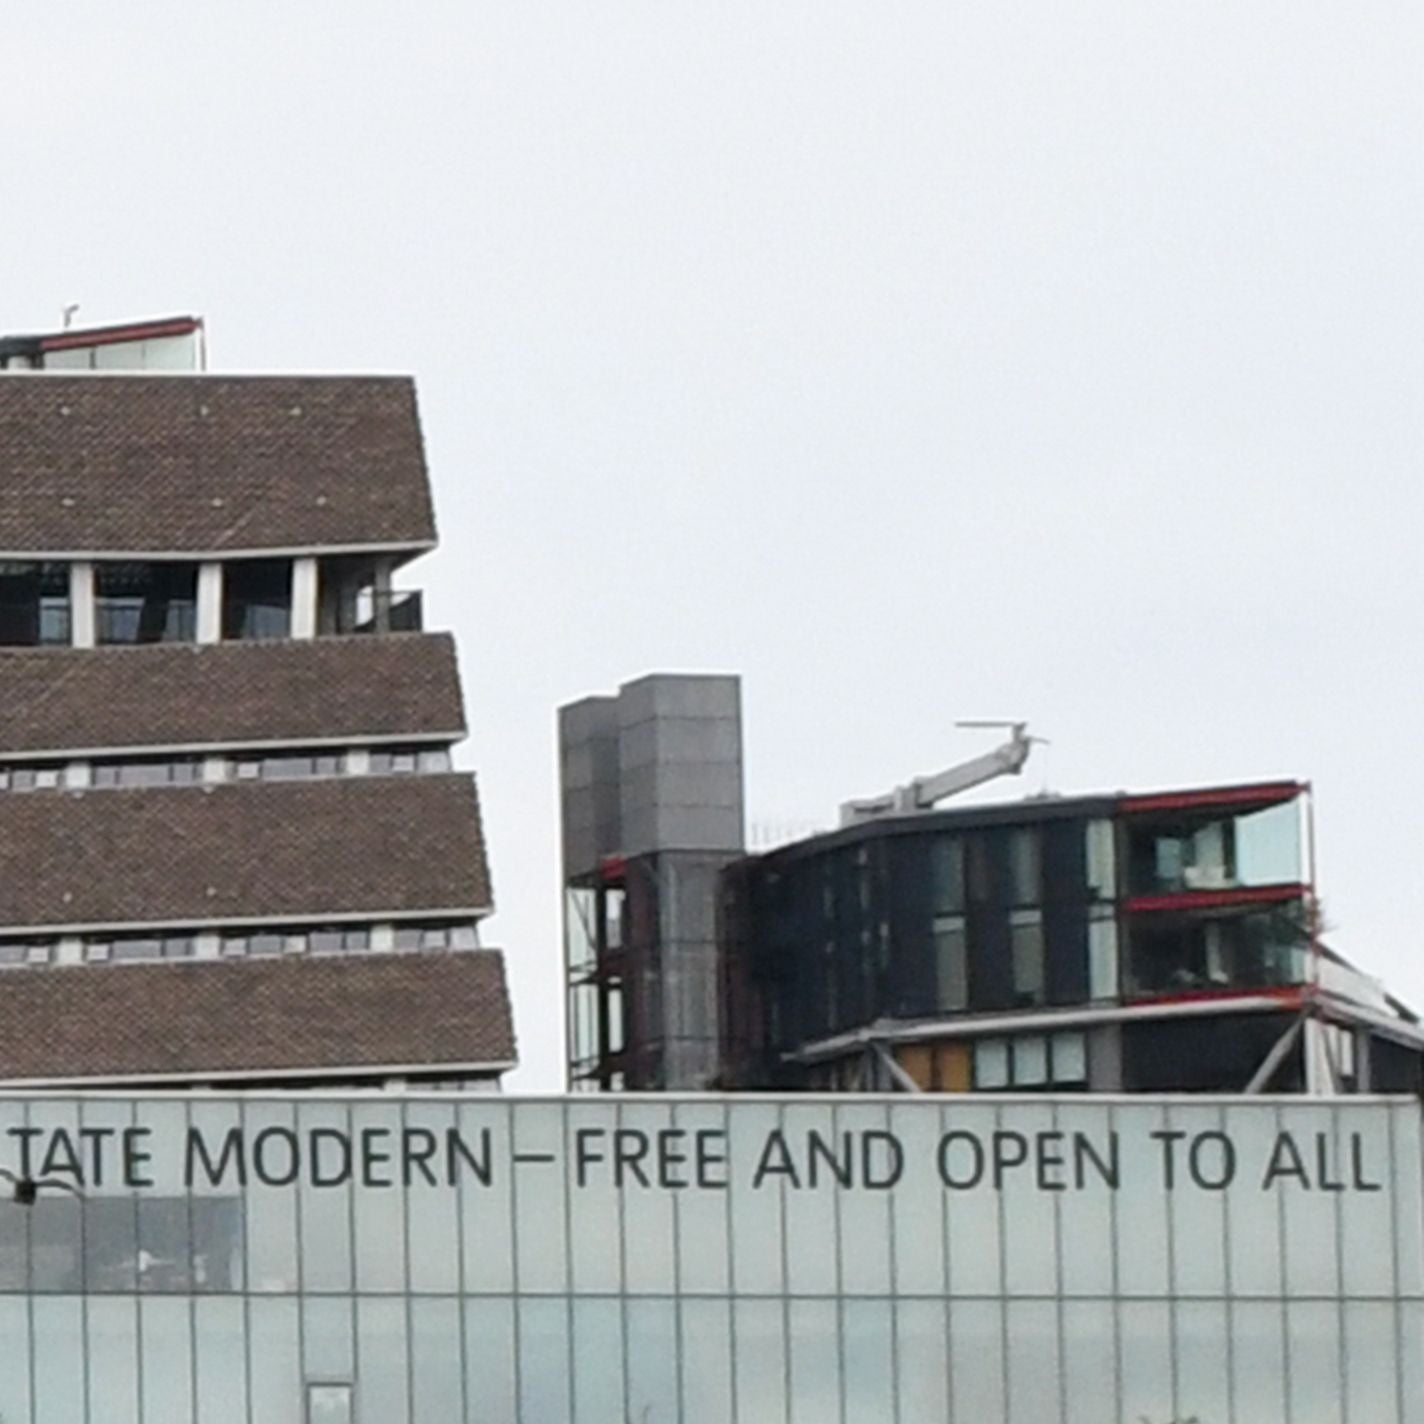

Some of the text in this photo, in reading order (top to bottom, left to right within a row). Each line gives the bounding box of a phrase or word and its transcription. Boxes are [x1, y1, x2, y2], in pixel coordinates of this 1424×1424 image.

[6, 1127, 154, 1187] TATE
[184, 1126, 493, 1187] MODERN
[576, 1128, 728, 1188] FREE
[752, 1129, 904, 1190] AND
[937, 1130, 1120, 1191] OPEN
[1150, 1130, 1236, 1190] TO
[1261, 1131, 1382, 1191] ALL
